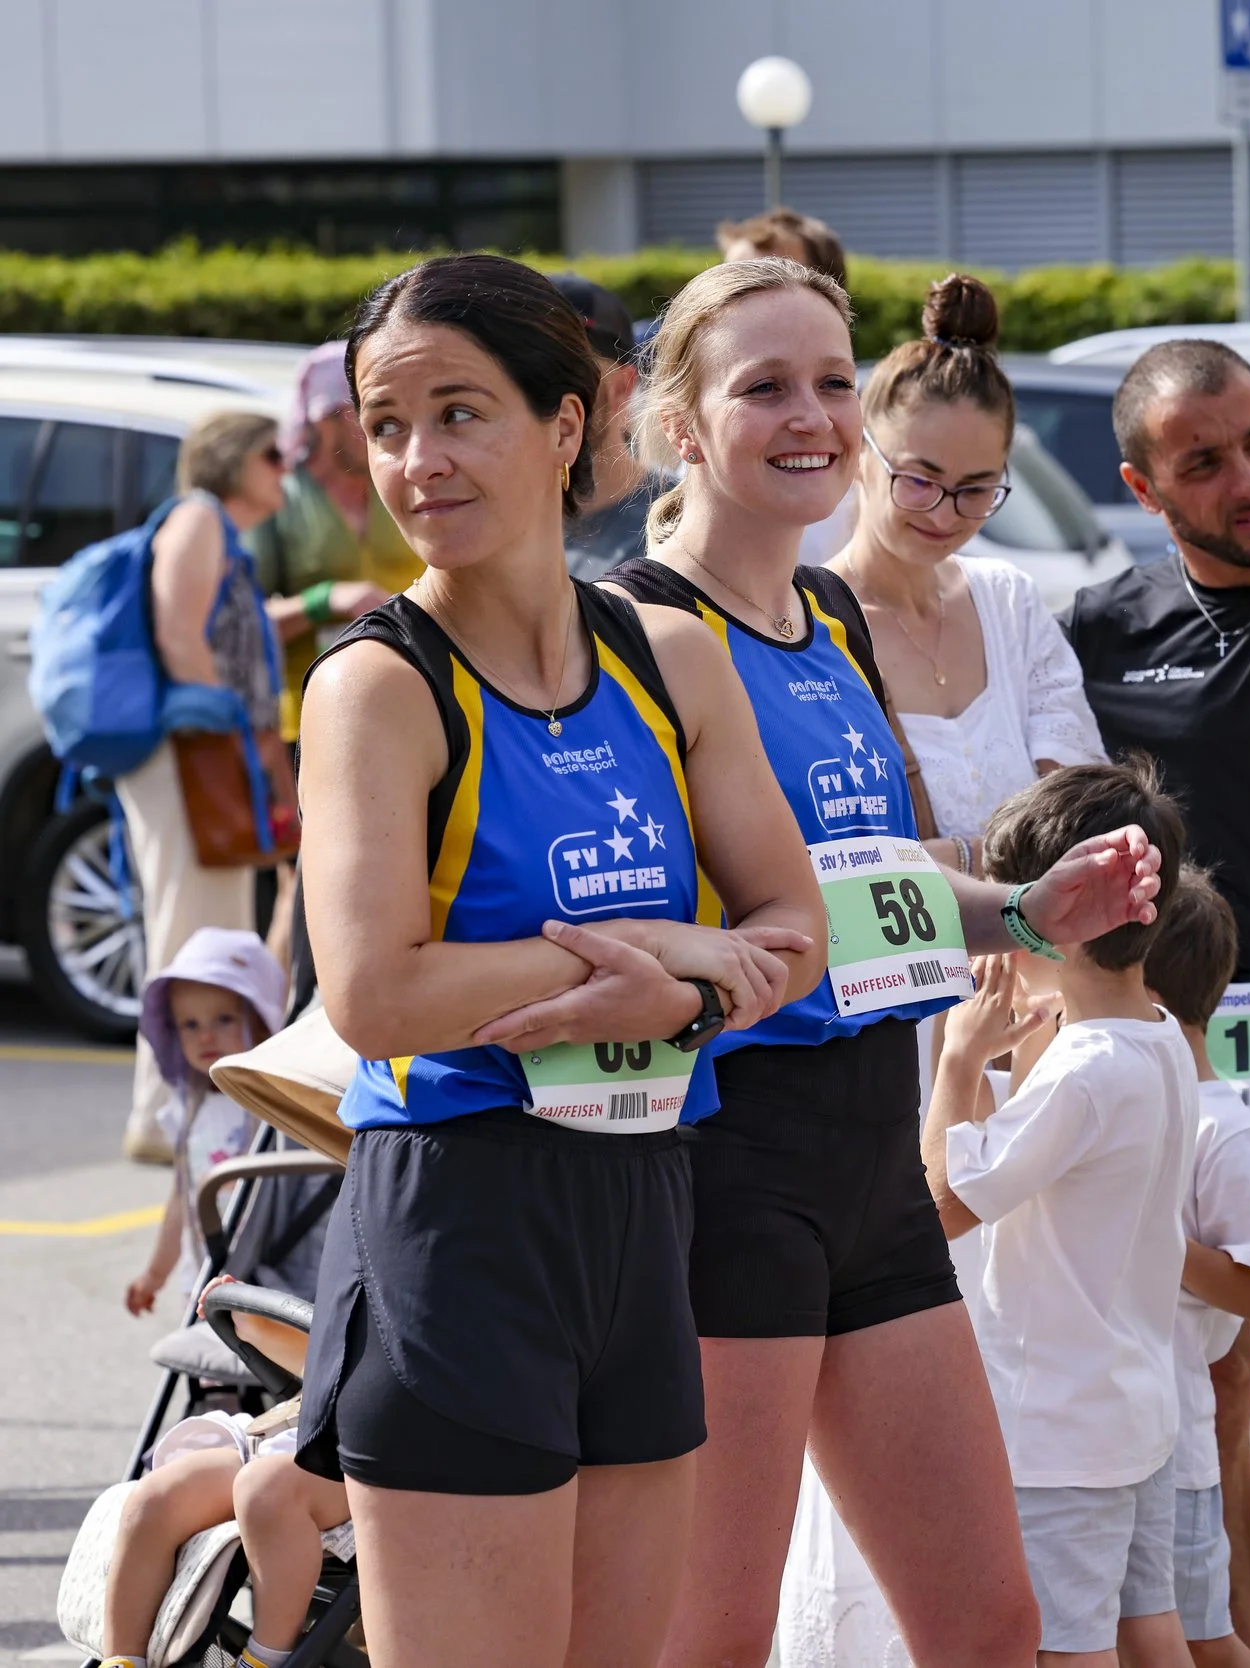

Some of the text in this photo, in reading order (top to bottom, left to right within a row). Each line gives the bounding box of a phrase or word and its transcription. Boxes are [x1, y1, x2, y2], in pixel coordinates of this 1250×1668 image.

[588, 757, 618, 774] sport
[817, 773, 842, 794] TV
[822, 794, 888, 820] NATERS
[562, 847, 599, 871] TV
[819, 852, 837, 872] stv
[848, 845, 883, 869] gampel
[568, 865, 667, 901] NATERS
[868, 878, 937, 947] 58
[840, 973, 907, 998] RAIFFEISEN
[535, 1103, 604, 1118] RAIFFEISEN
